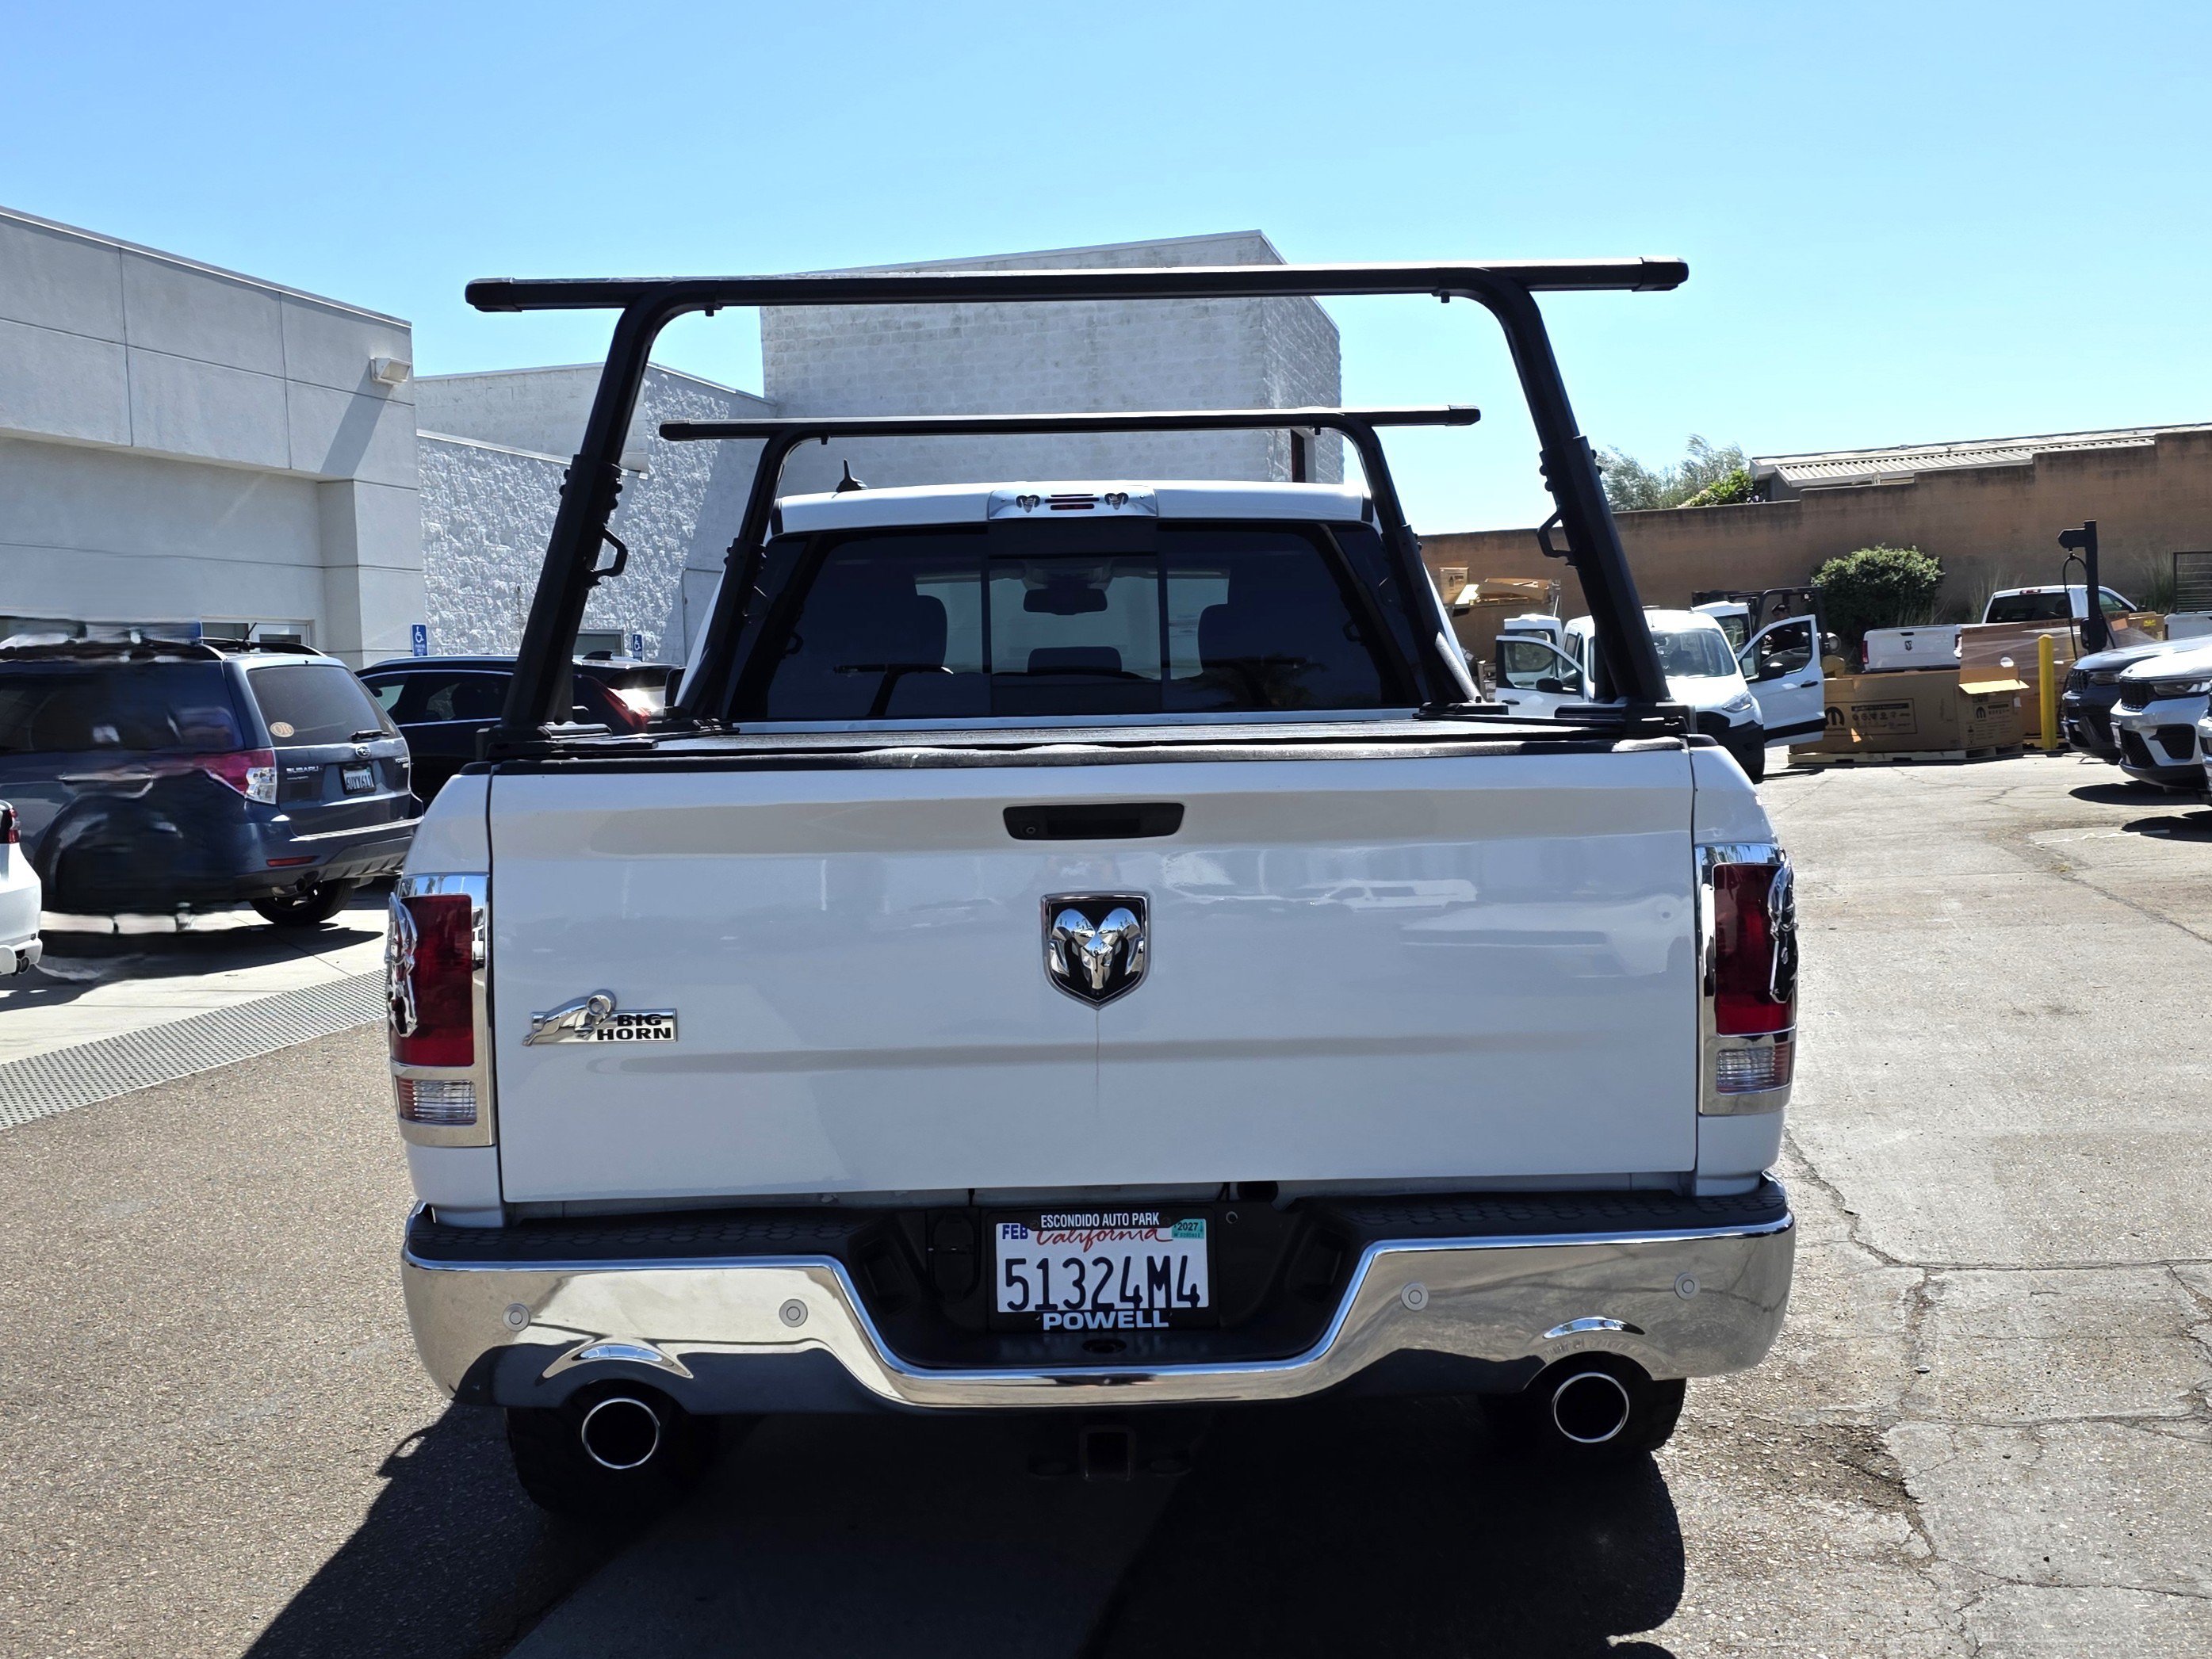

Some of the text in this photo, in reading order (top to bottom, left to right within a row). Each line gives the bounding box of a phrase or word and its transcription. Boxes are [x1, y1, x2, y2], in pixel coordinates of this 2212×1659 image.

[617, 1014, 662, 1026] BIG
[597, 1027, 672, 1040] HORN
[1041, 1212, 1160, 1228] ESCONDIDO AUTO PARK
[1177, 1221, 1199, 1231] 2027
[1002, 1225, 1028, 1239] FEB
[1036, 1228, 1173, 1252] California
[1005, 1256, 1200, 1311] 51324M4
[1043, 1310, 1169, 1330] POWELL
